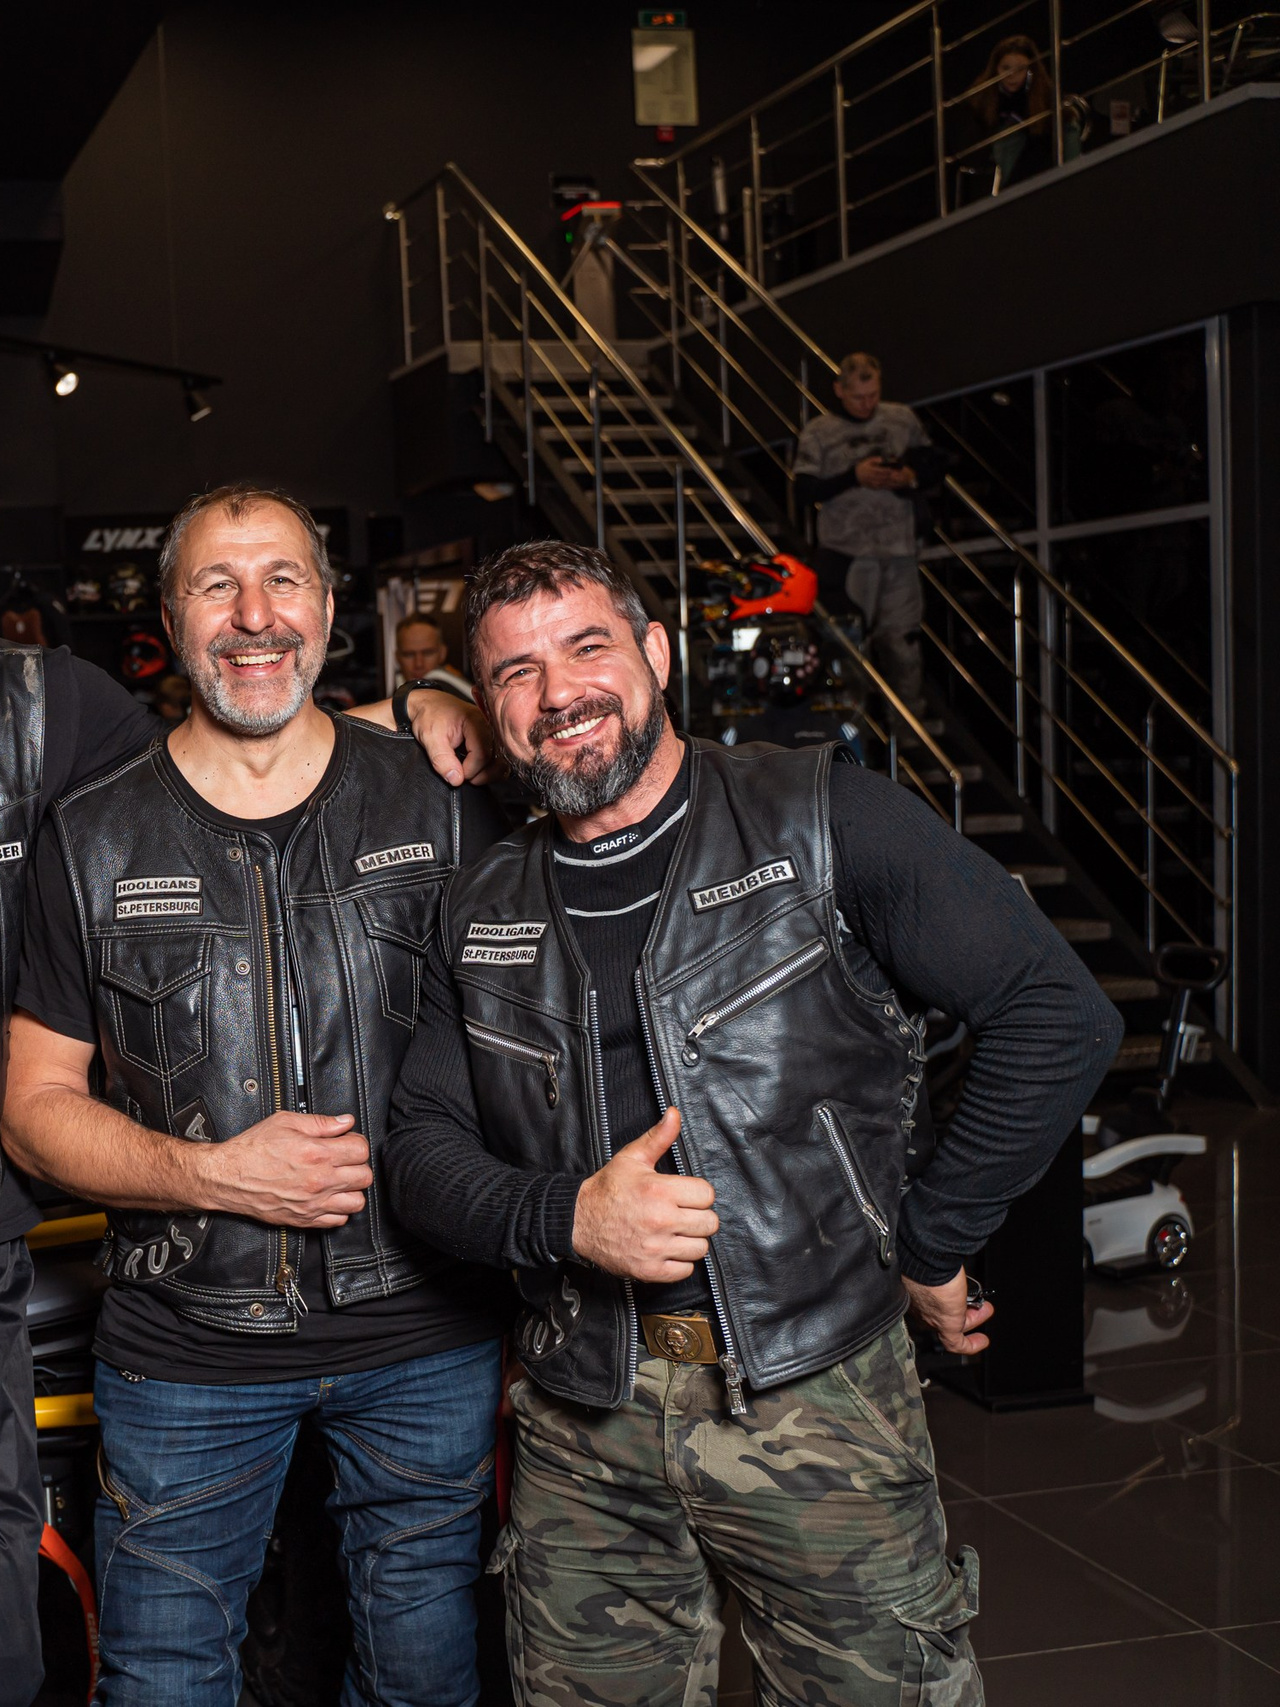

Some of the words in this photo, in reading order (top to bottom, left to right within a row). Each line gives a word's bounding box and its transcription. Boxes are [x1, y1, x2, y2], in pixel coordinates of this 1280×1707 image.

[81, 525, 166, 554] LYNX
[593, 834, 628, 854] CRAFT
[360, 846, 431, 870] MEMBER
[118, 880, 197, 893] HOOLIGANS
[699, 865, 788, 906] MEMBER
[118, 902, 199, 915] St.PETERSBURG
[470, 926, 542, 937] HOOLIGANS
[463, 949, 535, 961] St.PETERSBURG
